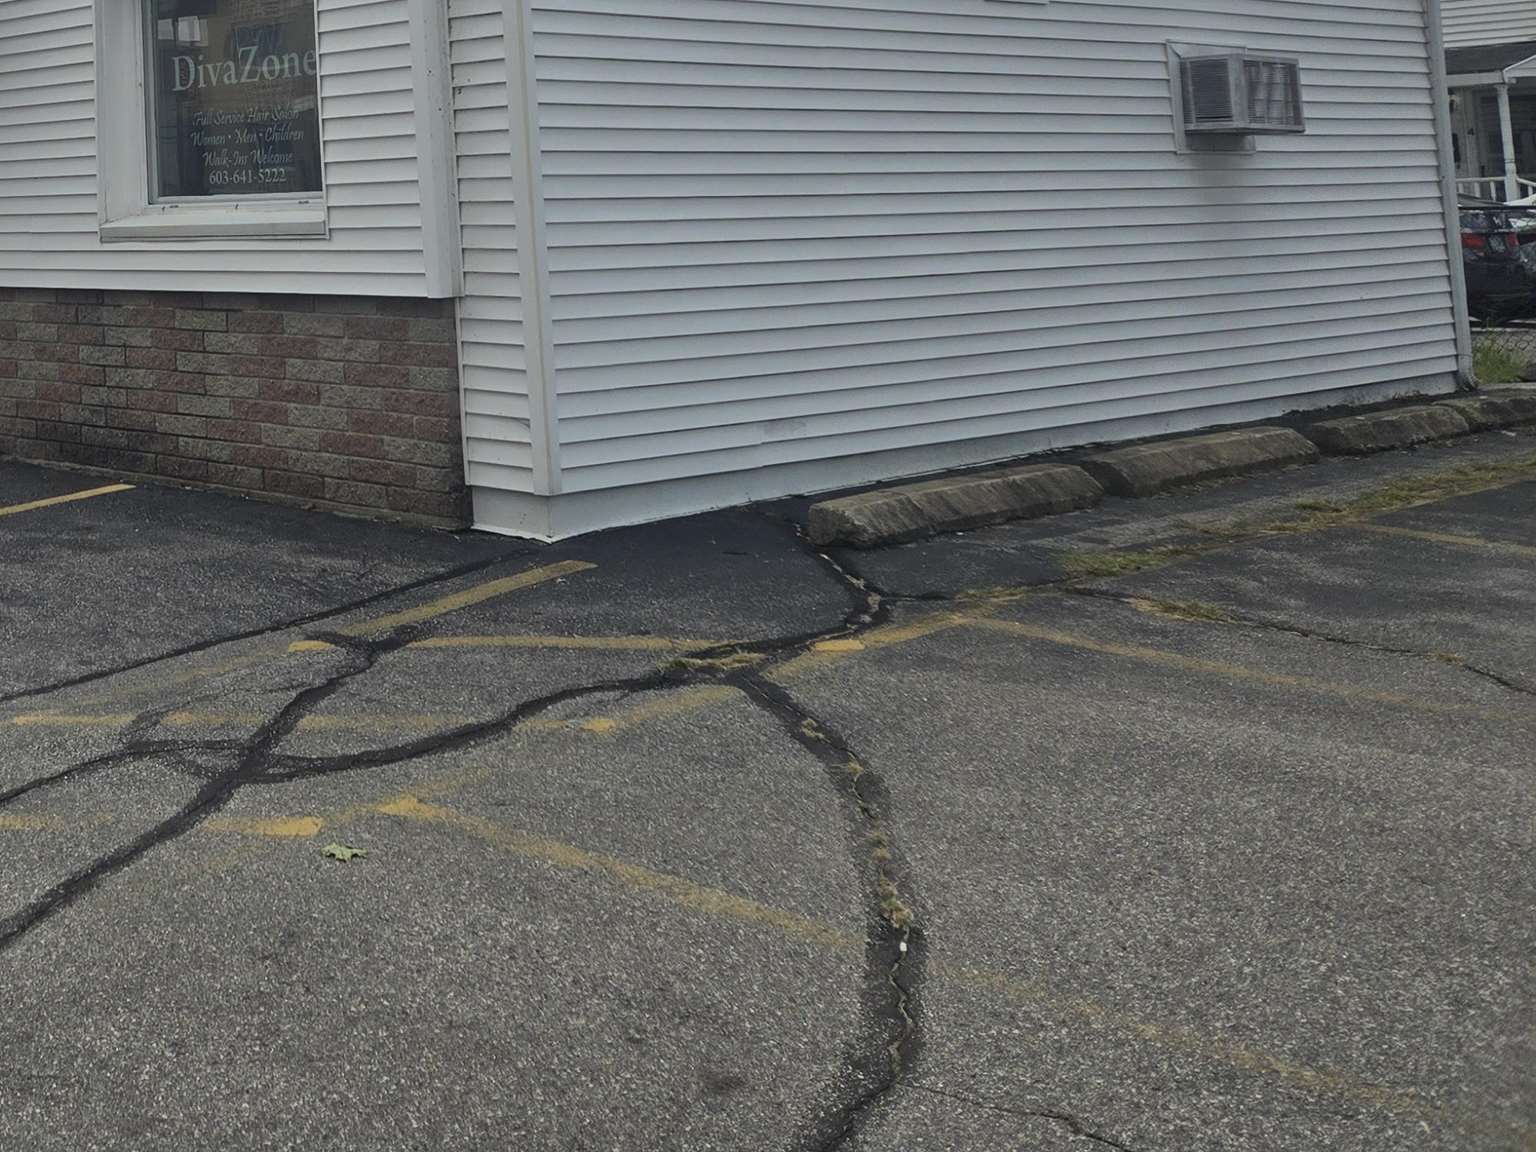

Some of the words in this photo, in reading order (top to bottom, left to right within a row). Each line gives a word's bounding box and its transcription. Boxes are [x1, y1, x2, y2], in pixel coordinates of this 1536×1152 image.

[171, 45, 317, 91] DivaZone
[265, 121, 304, 142] Children
[209, 168, 287, 185] 603-641-5222
